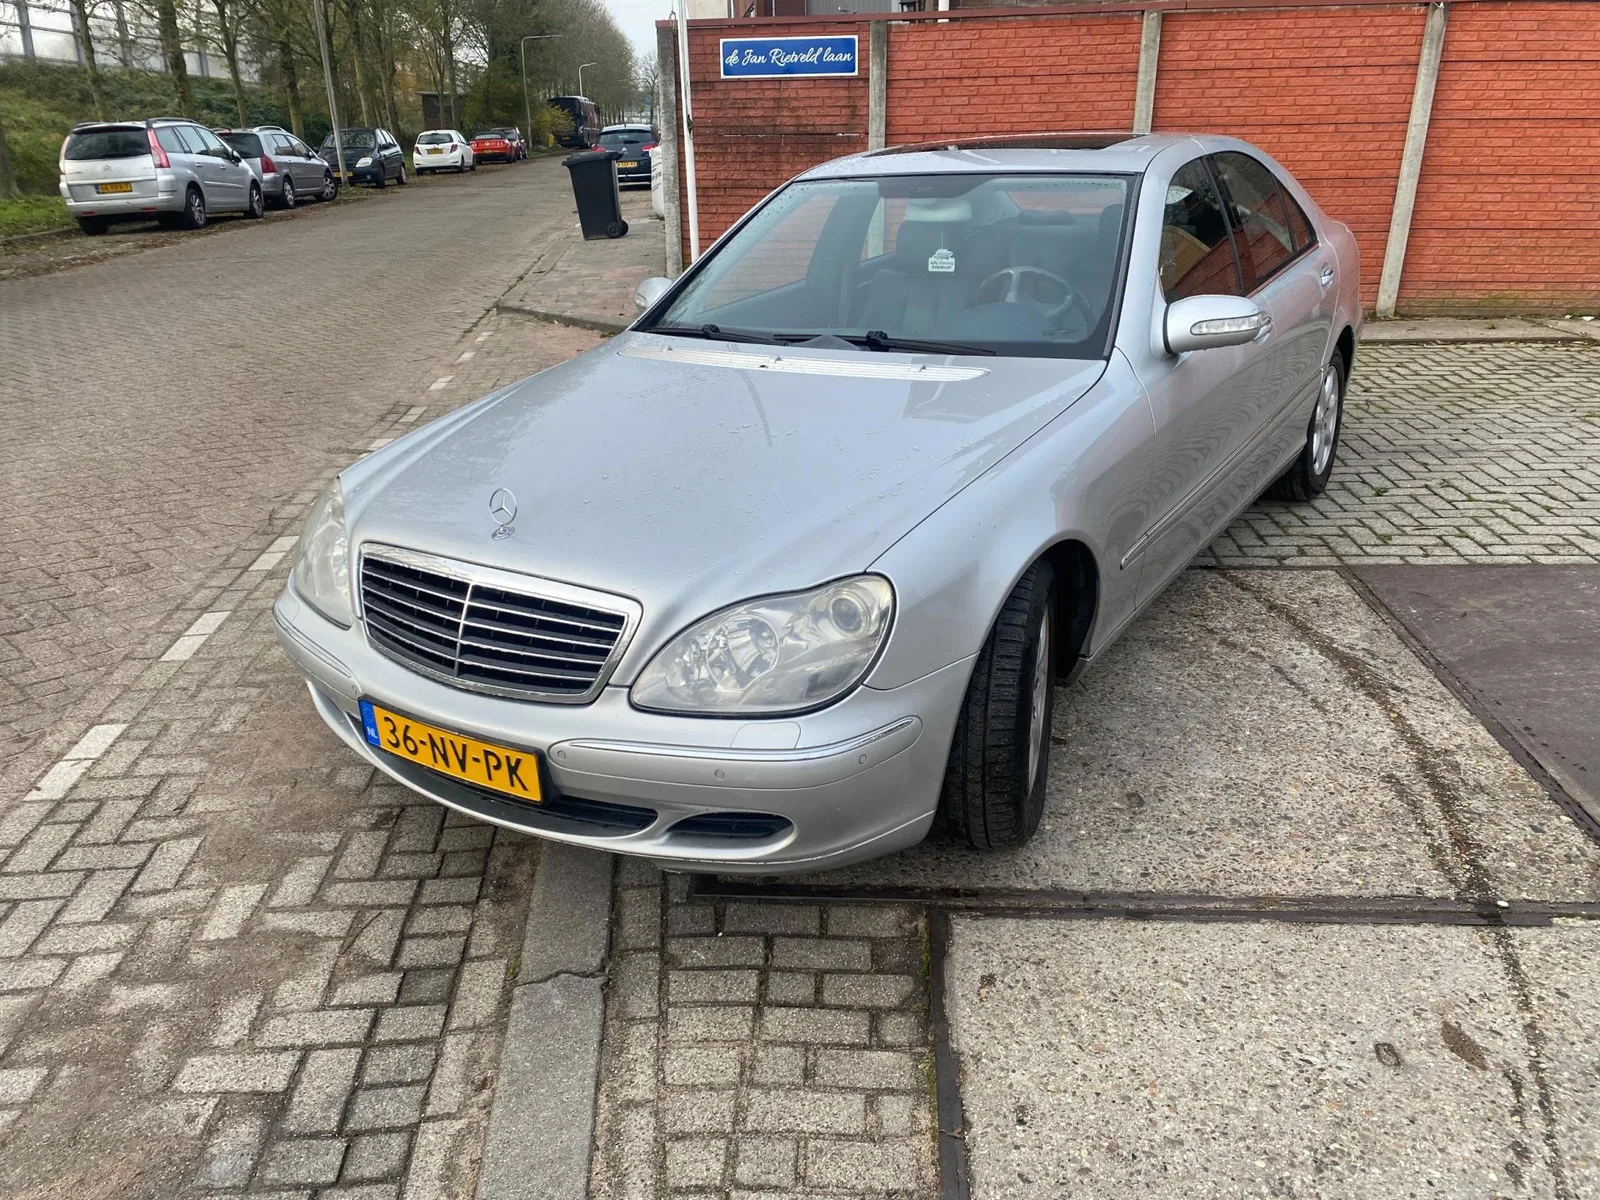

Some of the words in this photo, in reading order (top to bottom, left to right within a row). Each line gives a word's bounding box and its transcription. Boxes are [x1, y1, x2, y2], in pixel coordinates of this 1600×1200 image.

[725, 49, 739, 66] de
[742, 48, 767, 66] Jan
[769, 47, 822, 66] Rietveld
[822, 46, 853, 63] laan
[366, 725, 379, 739] NL
[383, 716, 530, 792] 36-NV-PK
